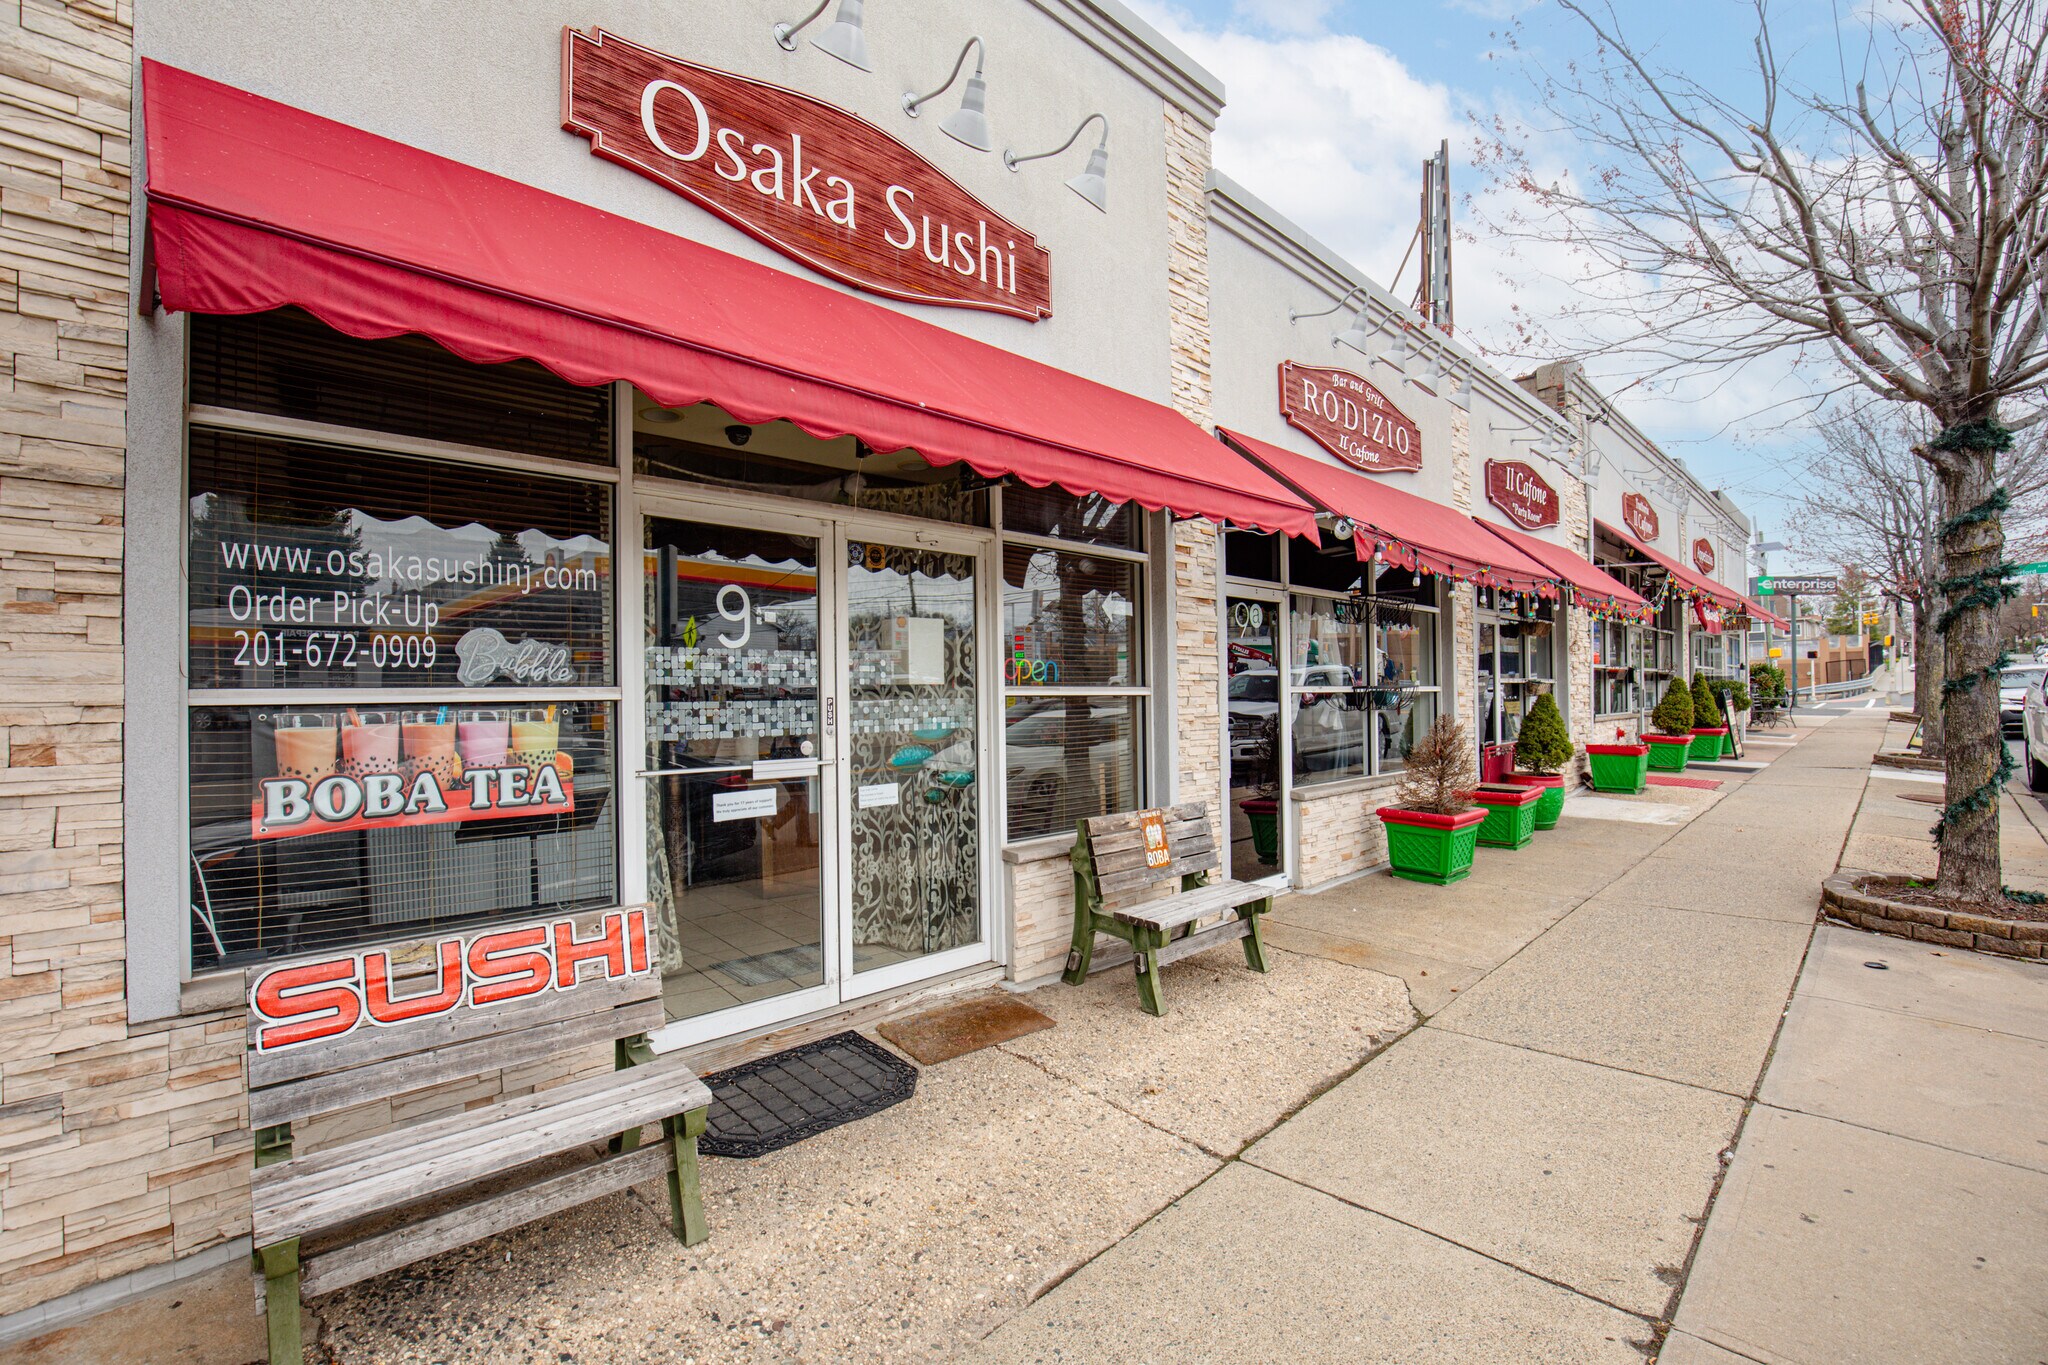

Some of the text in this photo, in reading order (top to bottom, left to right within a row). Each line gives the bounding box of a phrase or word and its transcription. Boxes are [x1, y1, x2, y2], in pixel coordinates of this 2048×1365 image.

[640, 79, 1017, 295] Osaka Sushi
[1333, 374, 1385, 409] Bar and Grill
[1302, 378, 1409, 454] RODIZIO
[1339, 434, 1380, 463] Il Cafone
[1506, 466, 1547, 506] Il Cafone
[221, 541, 598, 594] www.osakasushinj.com
[1758, 579, 1836, 591] enterprise
[228, 585, 439, 635] Order Pick-Up
[716, 584, 751, 649] 9
[233, 629, 437, 669] 201-672-0909
[463, 639, 573, 682] Bubble
[1004, 657, 1058, 686] open
[262, 765, 568, 828] BOBA TEA
[1147, 849, 1170, 867] BOBA
[251, 907, 652, 1054] SUSHI
